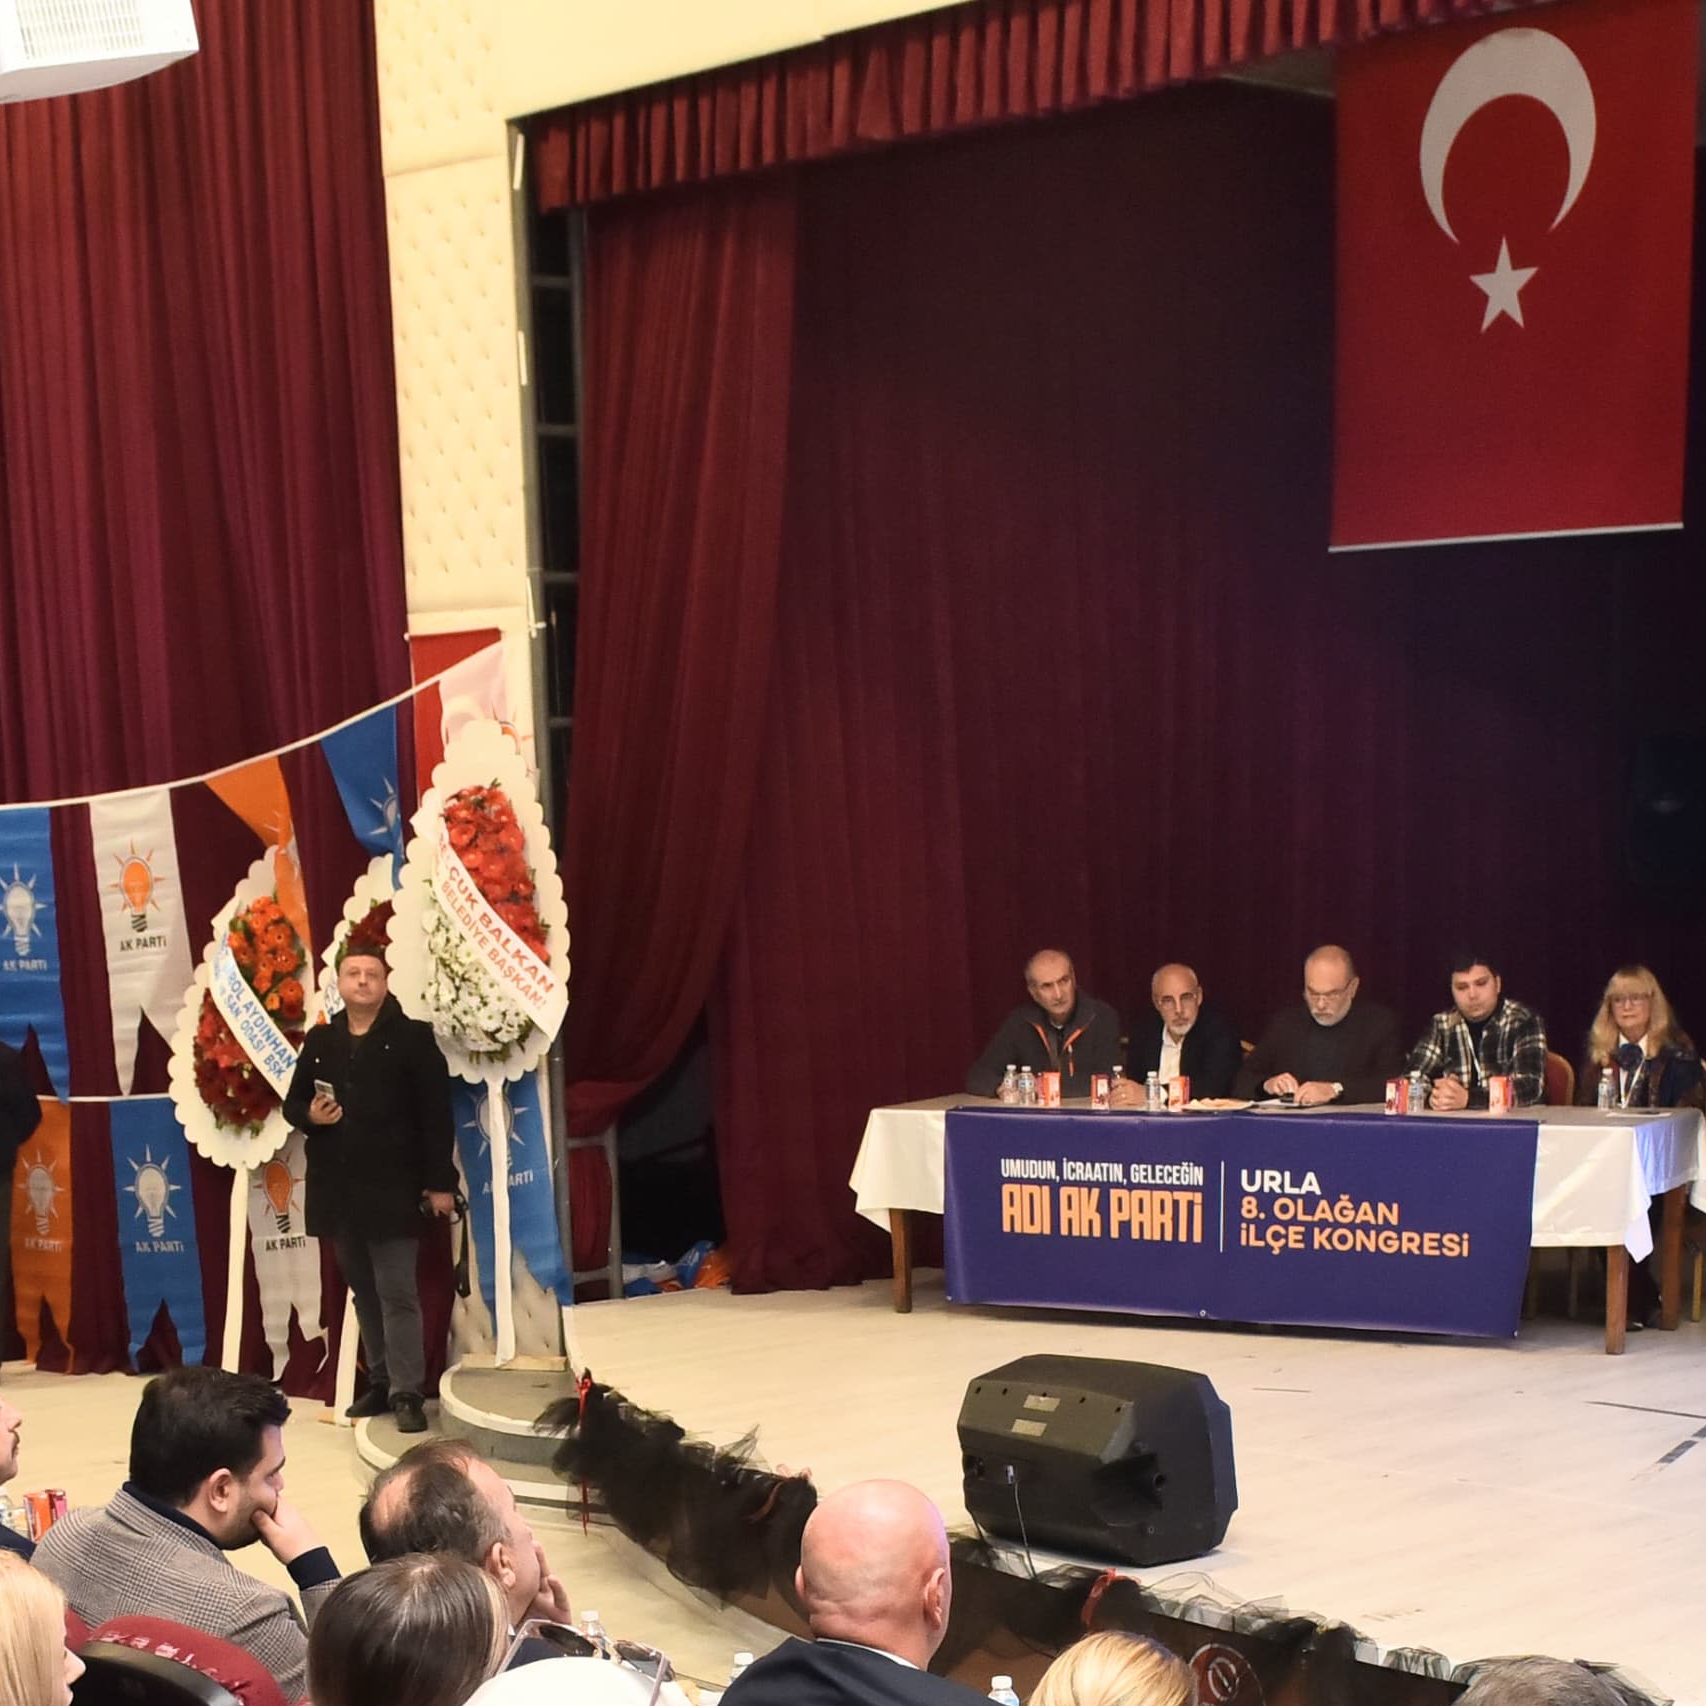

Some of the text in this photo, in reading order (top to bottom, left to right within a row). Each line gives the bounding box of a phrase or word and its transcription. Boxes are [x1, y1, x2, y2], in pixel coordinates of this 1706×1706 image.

[120, 939, 133, 951] AK
[479, 912, 554, 993] BALKAN
[1001, 1157, 1204, 1186] UMUDUN, İCRAATIN, GELECEĞİN
[1241, 1169, 1322, 1195] URLA
[1002, 1183, 1202, 1243] ADI AK PARTİ
[1241, 1194, 1399, 1226] 8. OLAĞAN
[265, 1239, 278, 1251] AK
[1240, 1222, 1470, 1258] İLÇE KONGRESİ
